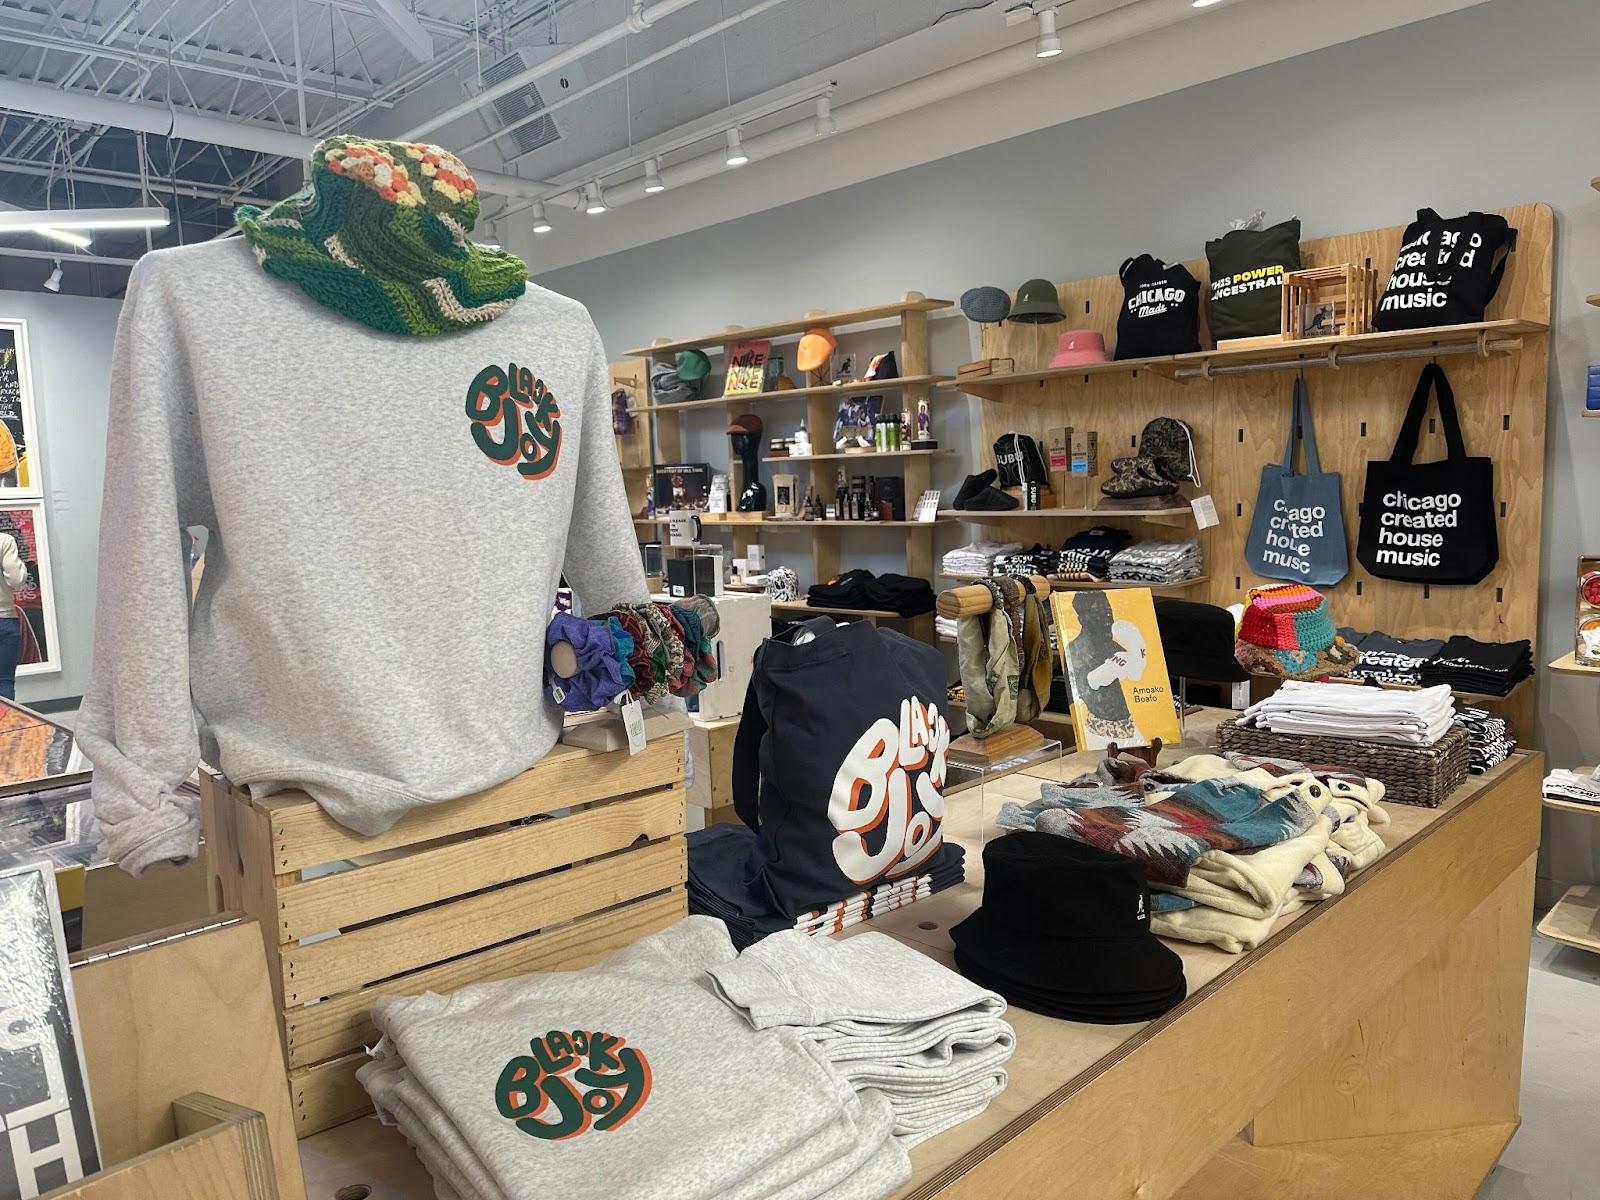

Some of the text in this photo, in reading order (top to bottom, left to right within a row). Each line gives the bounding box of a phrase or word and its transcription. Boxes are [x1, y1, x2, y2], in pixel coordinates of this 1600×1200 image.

[1233, 265, 1284, 285] POWER
[1128, 288, 1186, 310] CHICAGO
[1380, 288, 1448, 312] music
[1139, 303, 1167, 318] Made
[731, 350, 764, 368] NIKE
[1382, 490, 1462, 512] chicago
[1380, 509, 1458, 529] created
[1378, 526, 1444, 548] house
[1375, 548, 1441, 567] music
[1132, 686, 1164, 695] Amoako
[1134, 695, 1158, 704] Boafo
